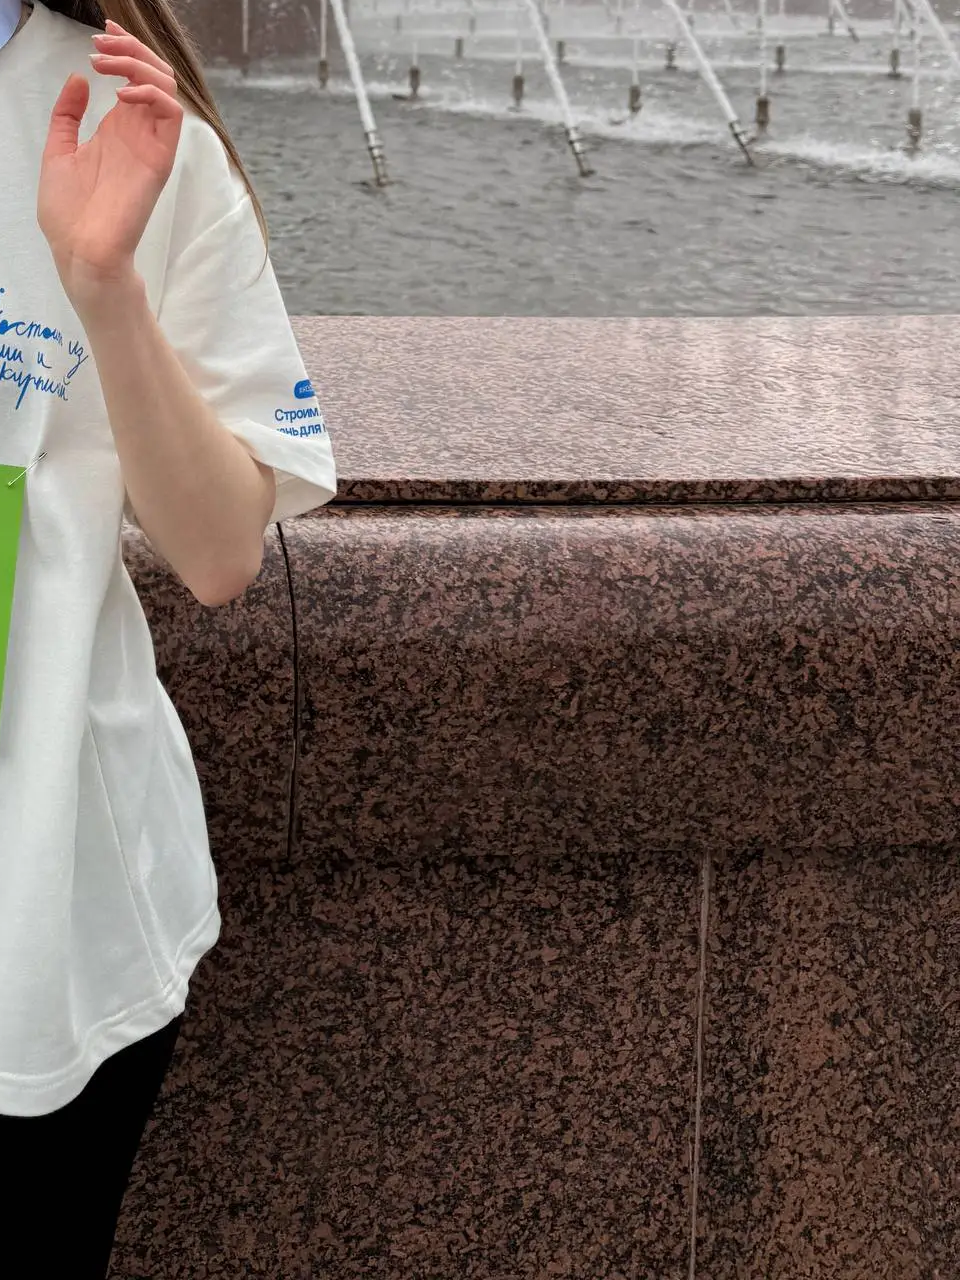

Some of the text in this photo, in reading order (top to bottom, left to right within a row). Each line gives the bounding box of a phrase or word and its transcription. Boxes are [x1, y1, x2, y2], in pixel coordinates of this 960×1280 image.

[37, 351, 52, 369] и
[68, 340, 89, 380] из
[274, 407, 319, 423] Строим
[299, 423, 322, 437] для
